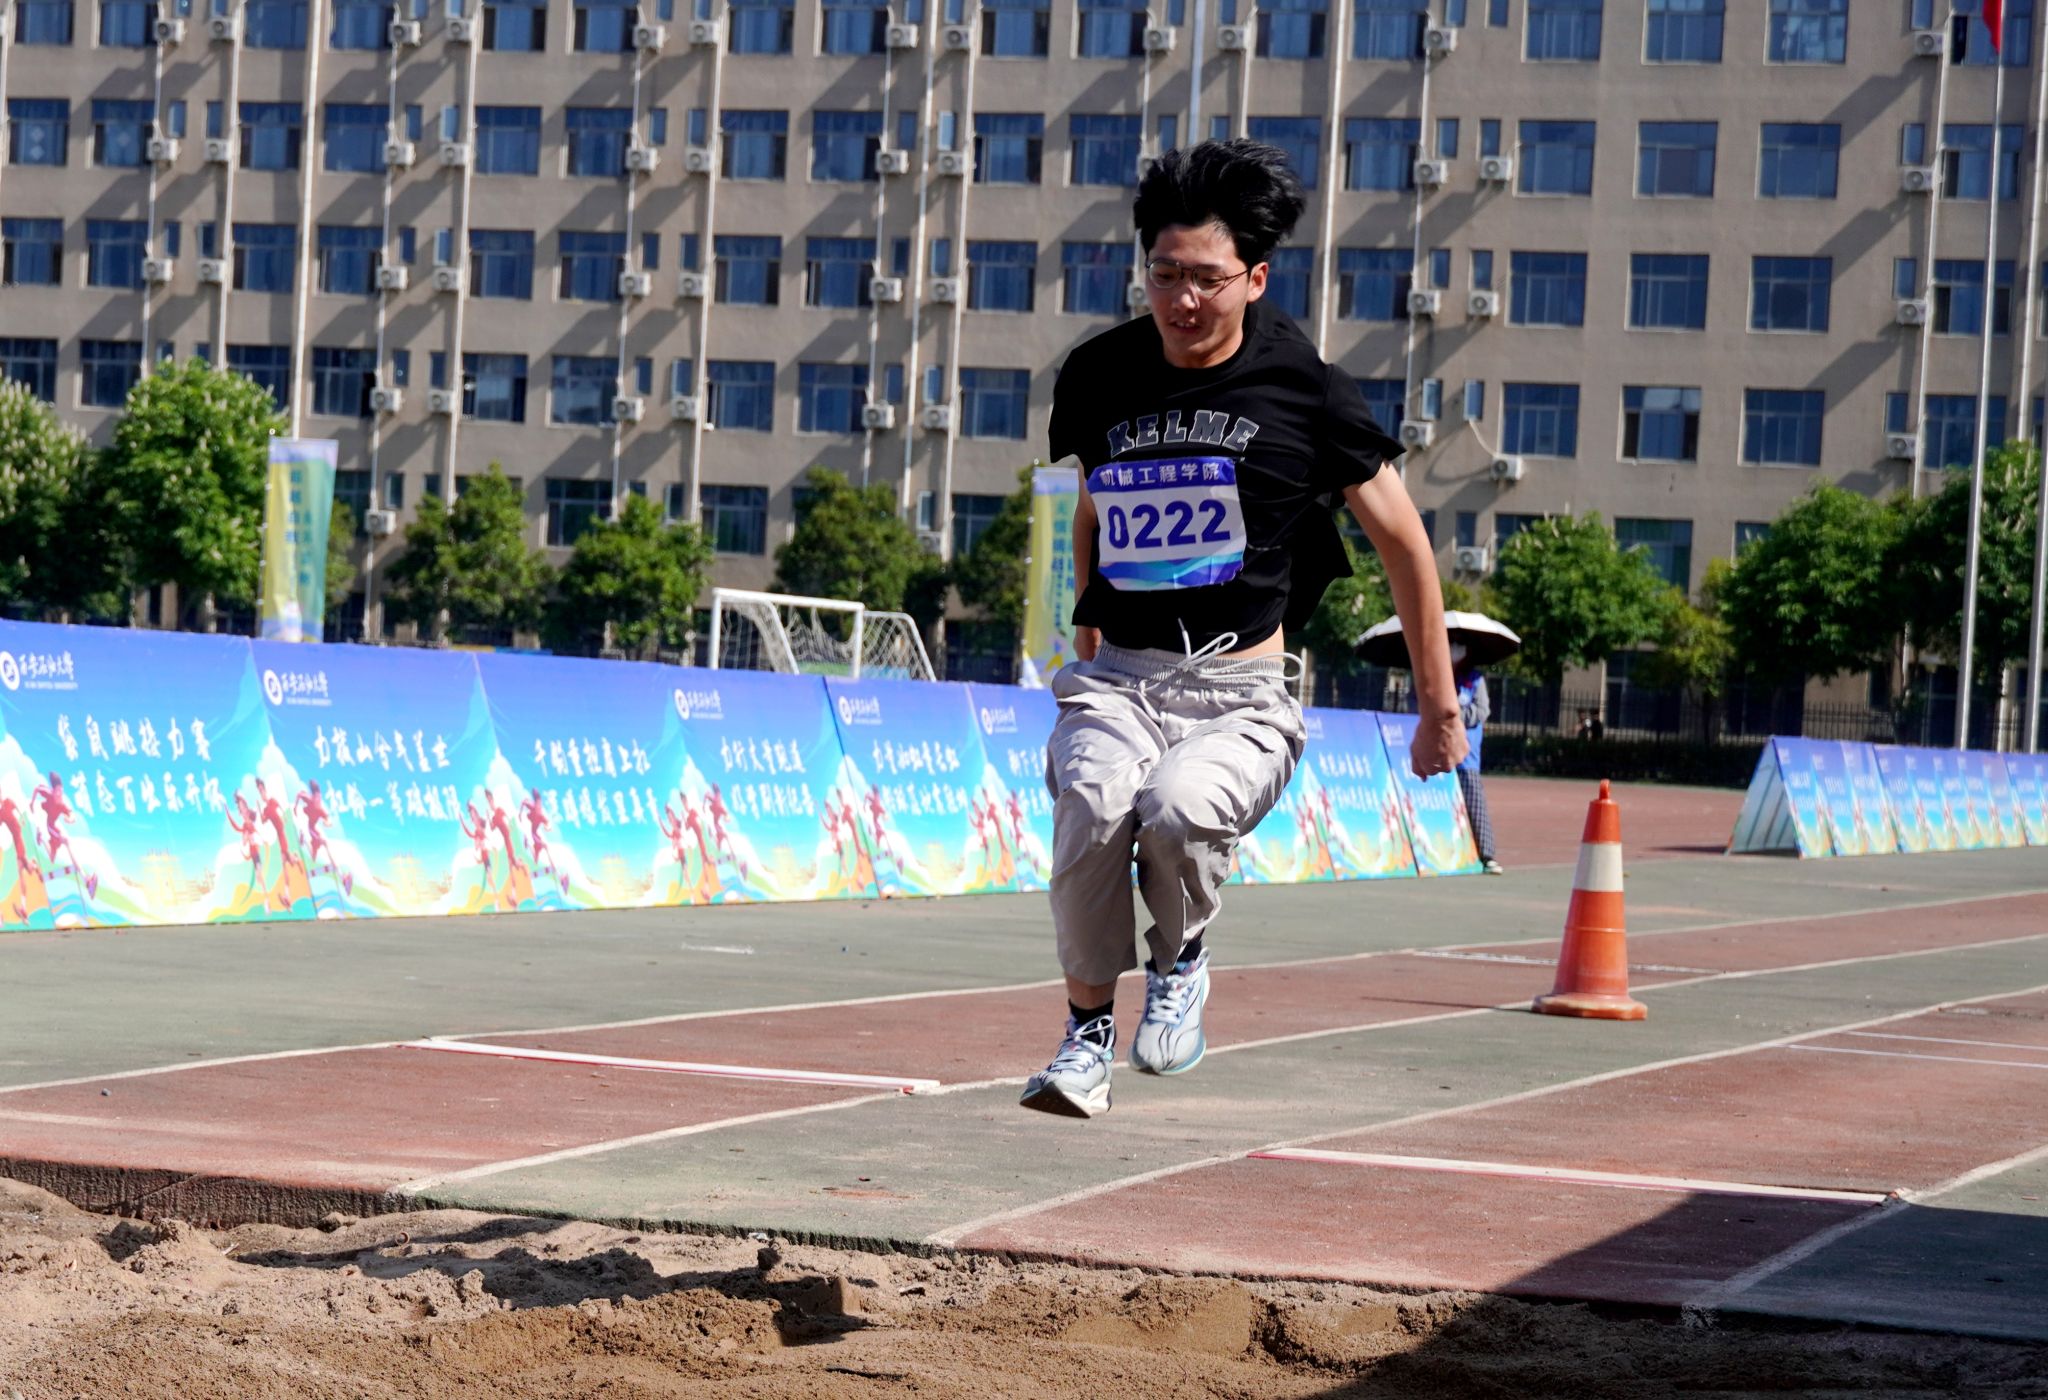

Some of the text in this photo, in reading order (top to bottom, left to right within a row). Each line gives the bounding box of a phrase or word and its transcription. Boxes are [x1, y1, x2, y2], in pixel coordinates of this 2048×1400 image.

[1107, 410, 1260, 459] KELME
[1100, 462, 1220, 487] 机械工程学院
[1107, 499, 1231, 549] 0222
